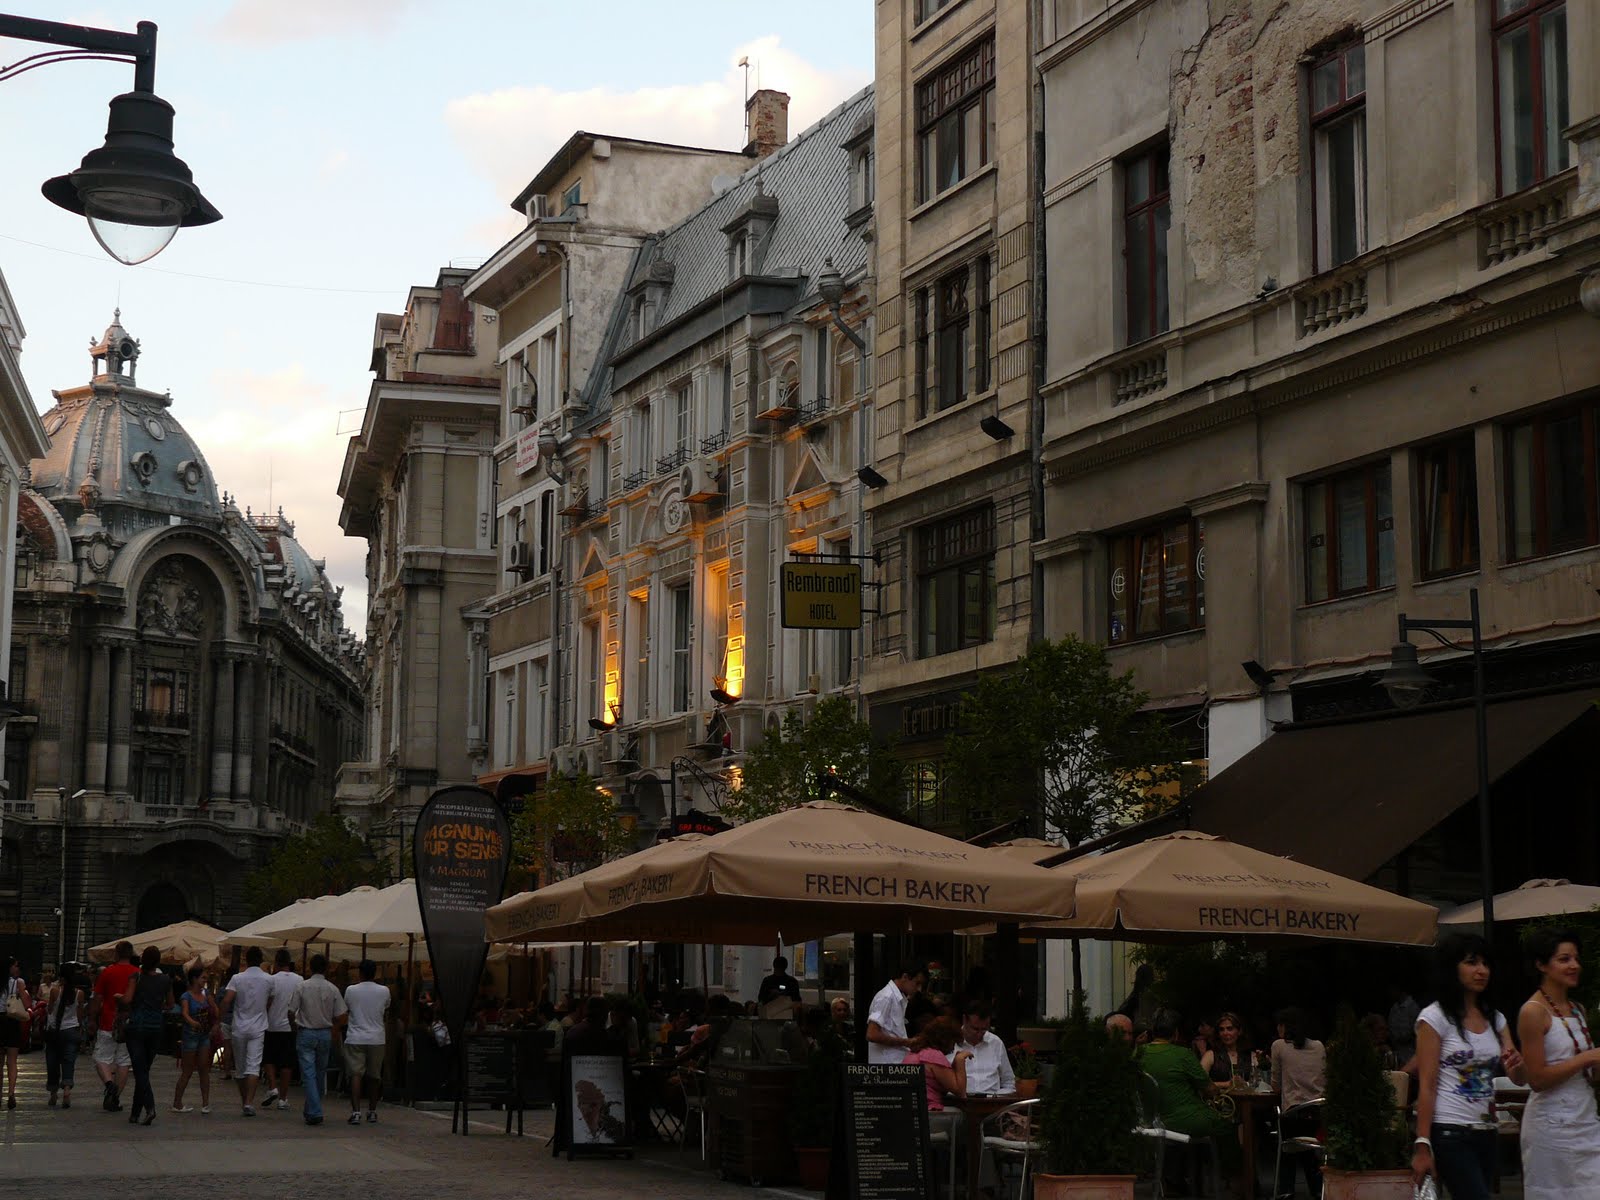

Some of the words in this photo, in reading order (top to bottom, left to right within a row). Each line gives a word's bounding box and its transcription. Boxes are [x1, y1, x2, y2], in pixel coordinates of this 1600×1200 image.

[809, 603, 837, 620] HOTEL
[789, 840, 883, 850] FRENCH
[888, 845, 969, 860] BAKERY
[608, 886, 638, 907] FRENCH
[641, 874, 675, 896] BAKERY
[806, 873, 897, 897] FRENCH
[906, 879, 990, 904] BAKERY
[1199, 907, 1280, 927] FRENCH
[1286, 911, 1360, 931] BAKERY
[847, 1065, 884, 1075] FRENCH
[888, 1065, 921, 1075] BAKERY
